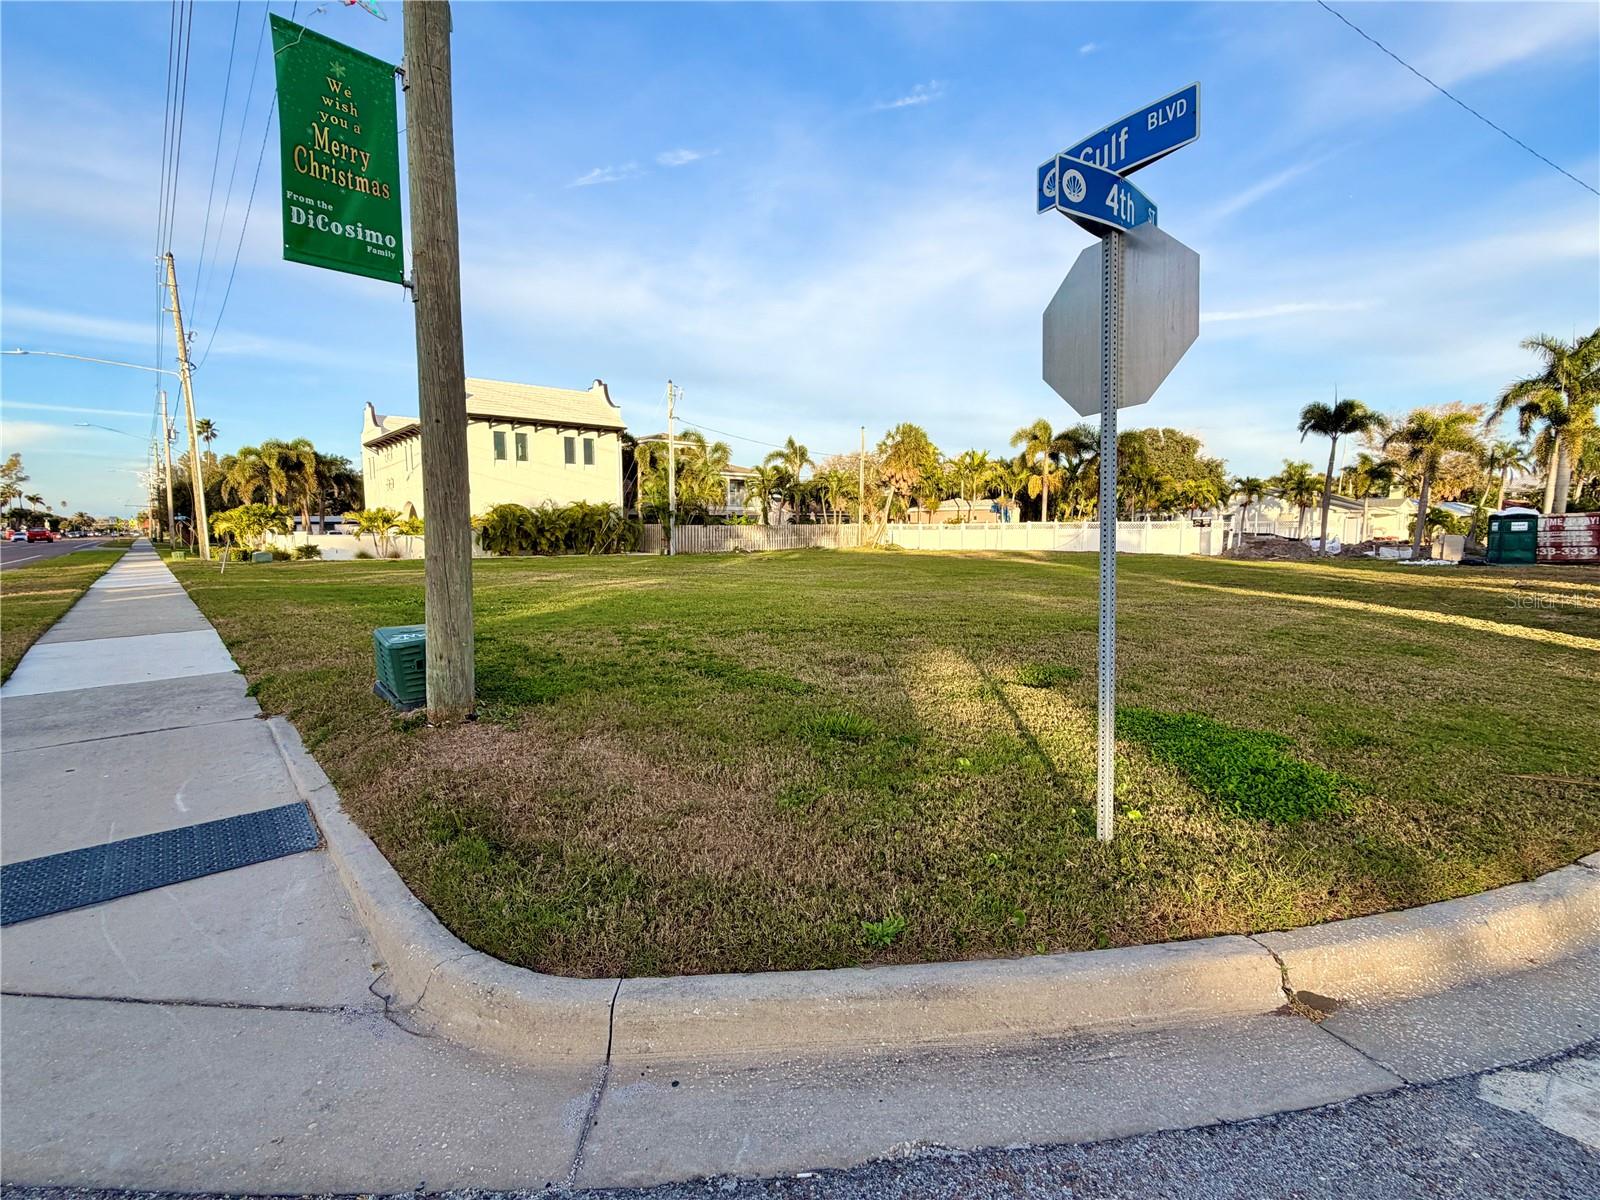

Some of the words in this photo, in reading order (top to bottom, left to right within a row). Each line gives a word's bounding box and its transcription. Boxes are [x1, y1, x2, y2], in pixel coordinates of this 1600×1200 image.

[326, 76, 352, 98] We
[319, 110, 348, 129] you
[353, 124, 361, 135] a
[321, 95, 358, 117] wish
[312, 122, 371, 172] Merry
[1079, 126, 1129, 168] Gulf
[1147, 98, 1187, 131] BLVD
[294, 145, 390, 199] Christmas
[286, 190, 315, 206] From
[317, 199, 334, 211] the
[1105, 183, 1136, 226] 4th
[290, 205, 396, 248] DiCosimo
[367, 245, 396, 260] Family
